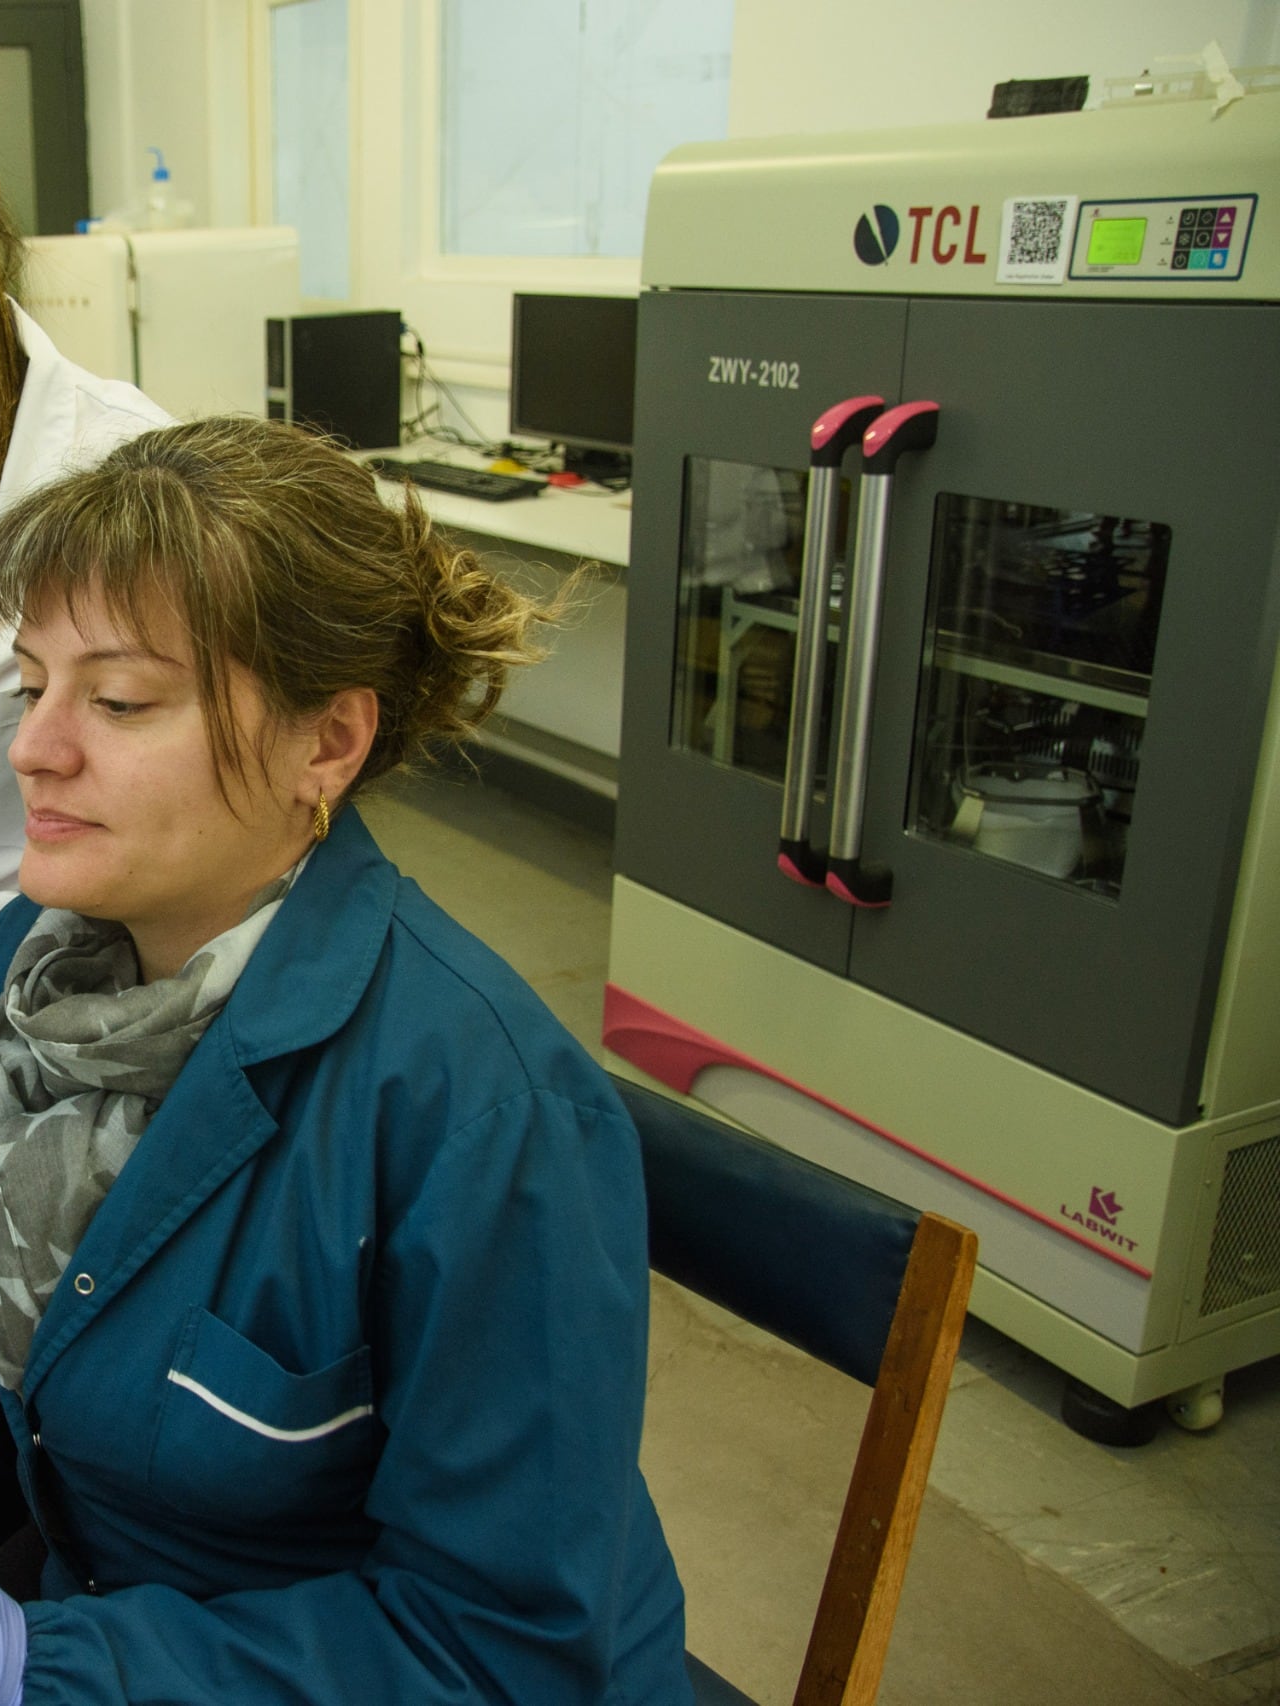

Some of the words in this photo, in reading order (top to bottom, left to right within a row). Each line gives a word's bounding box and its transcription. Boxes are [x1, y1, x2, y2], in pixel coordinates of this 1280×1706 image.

[908, 205, 986, 265] TCL
[708, 356, 800, 390] ZWY-2102
[1061, 1205, 1138, 1251] LABWIT
